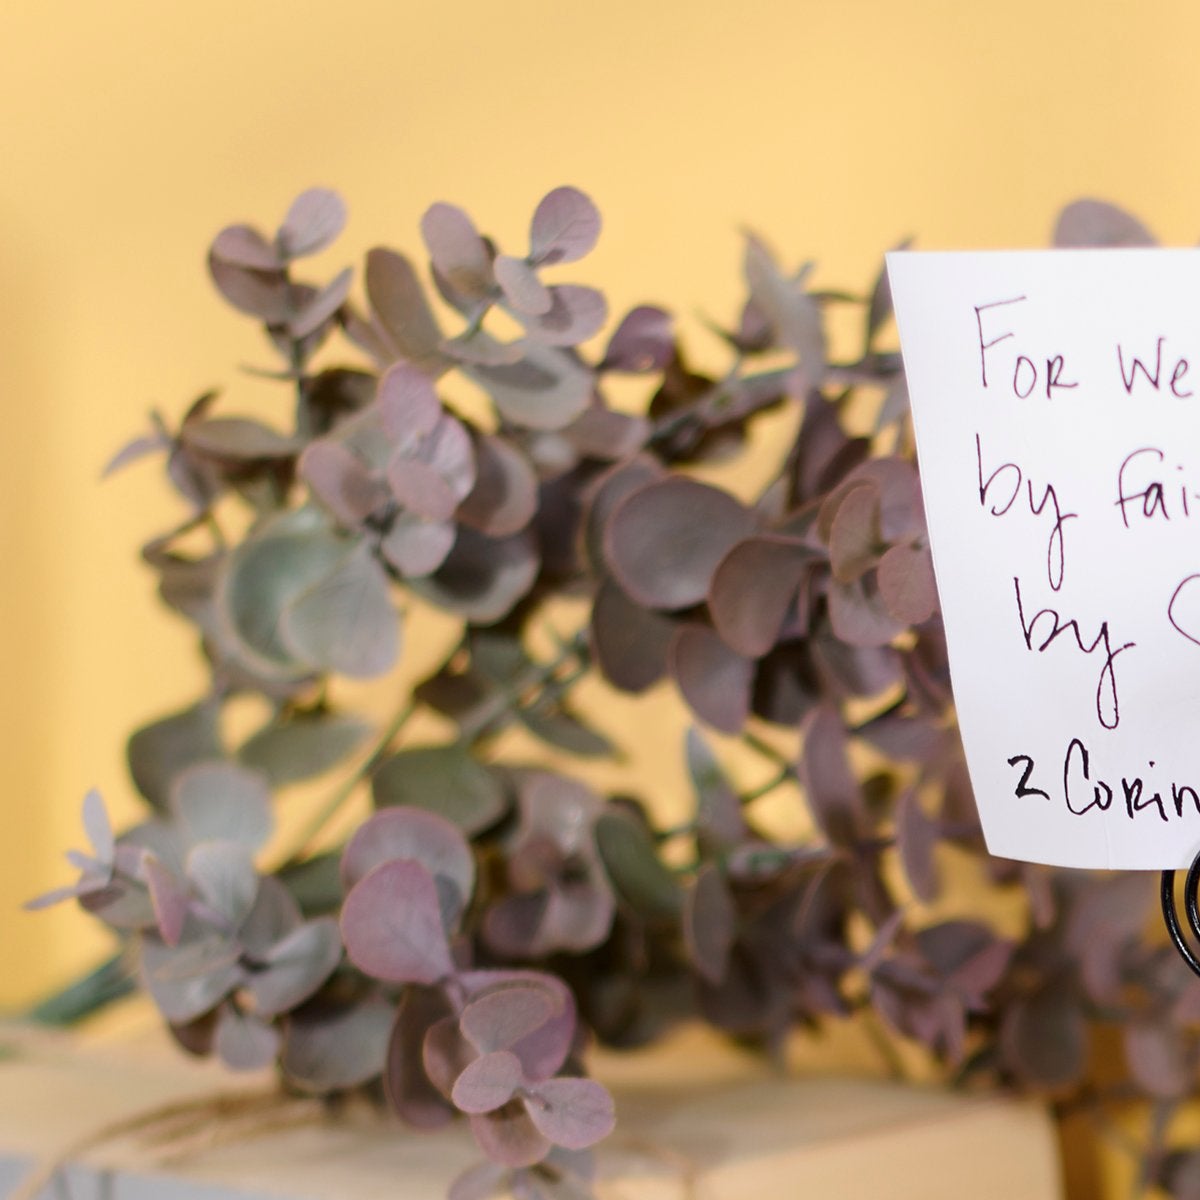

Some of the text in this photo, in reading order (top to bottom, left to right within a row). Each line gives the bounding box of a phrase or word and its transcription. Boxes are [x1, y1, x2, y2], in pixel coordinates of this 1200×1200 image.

[975, 433, 1078, 591] by
[1014, 577, 1136, 729] by
[1008, 756, 1051, 801] 2
